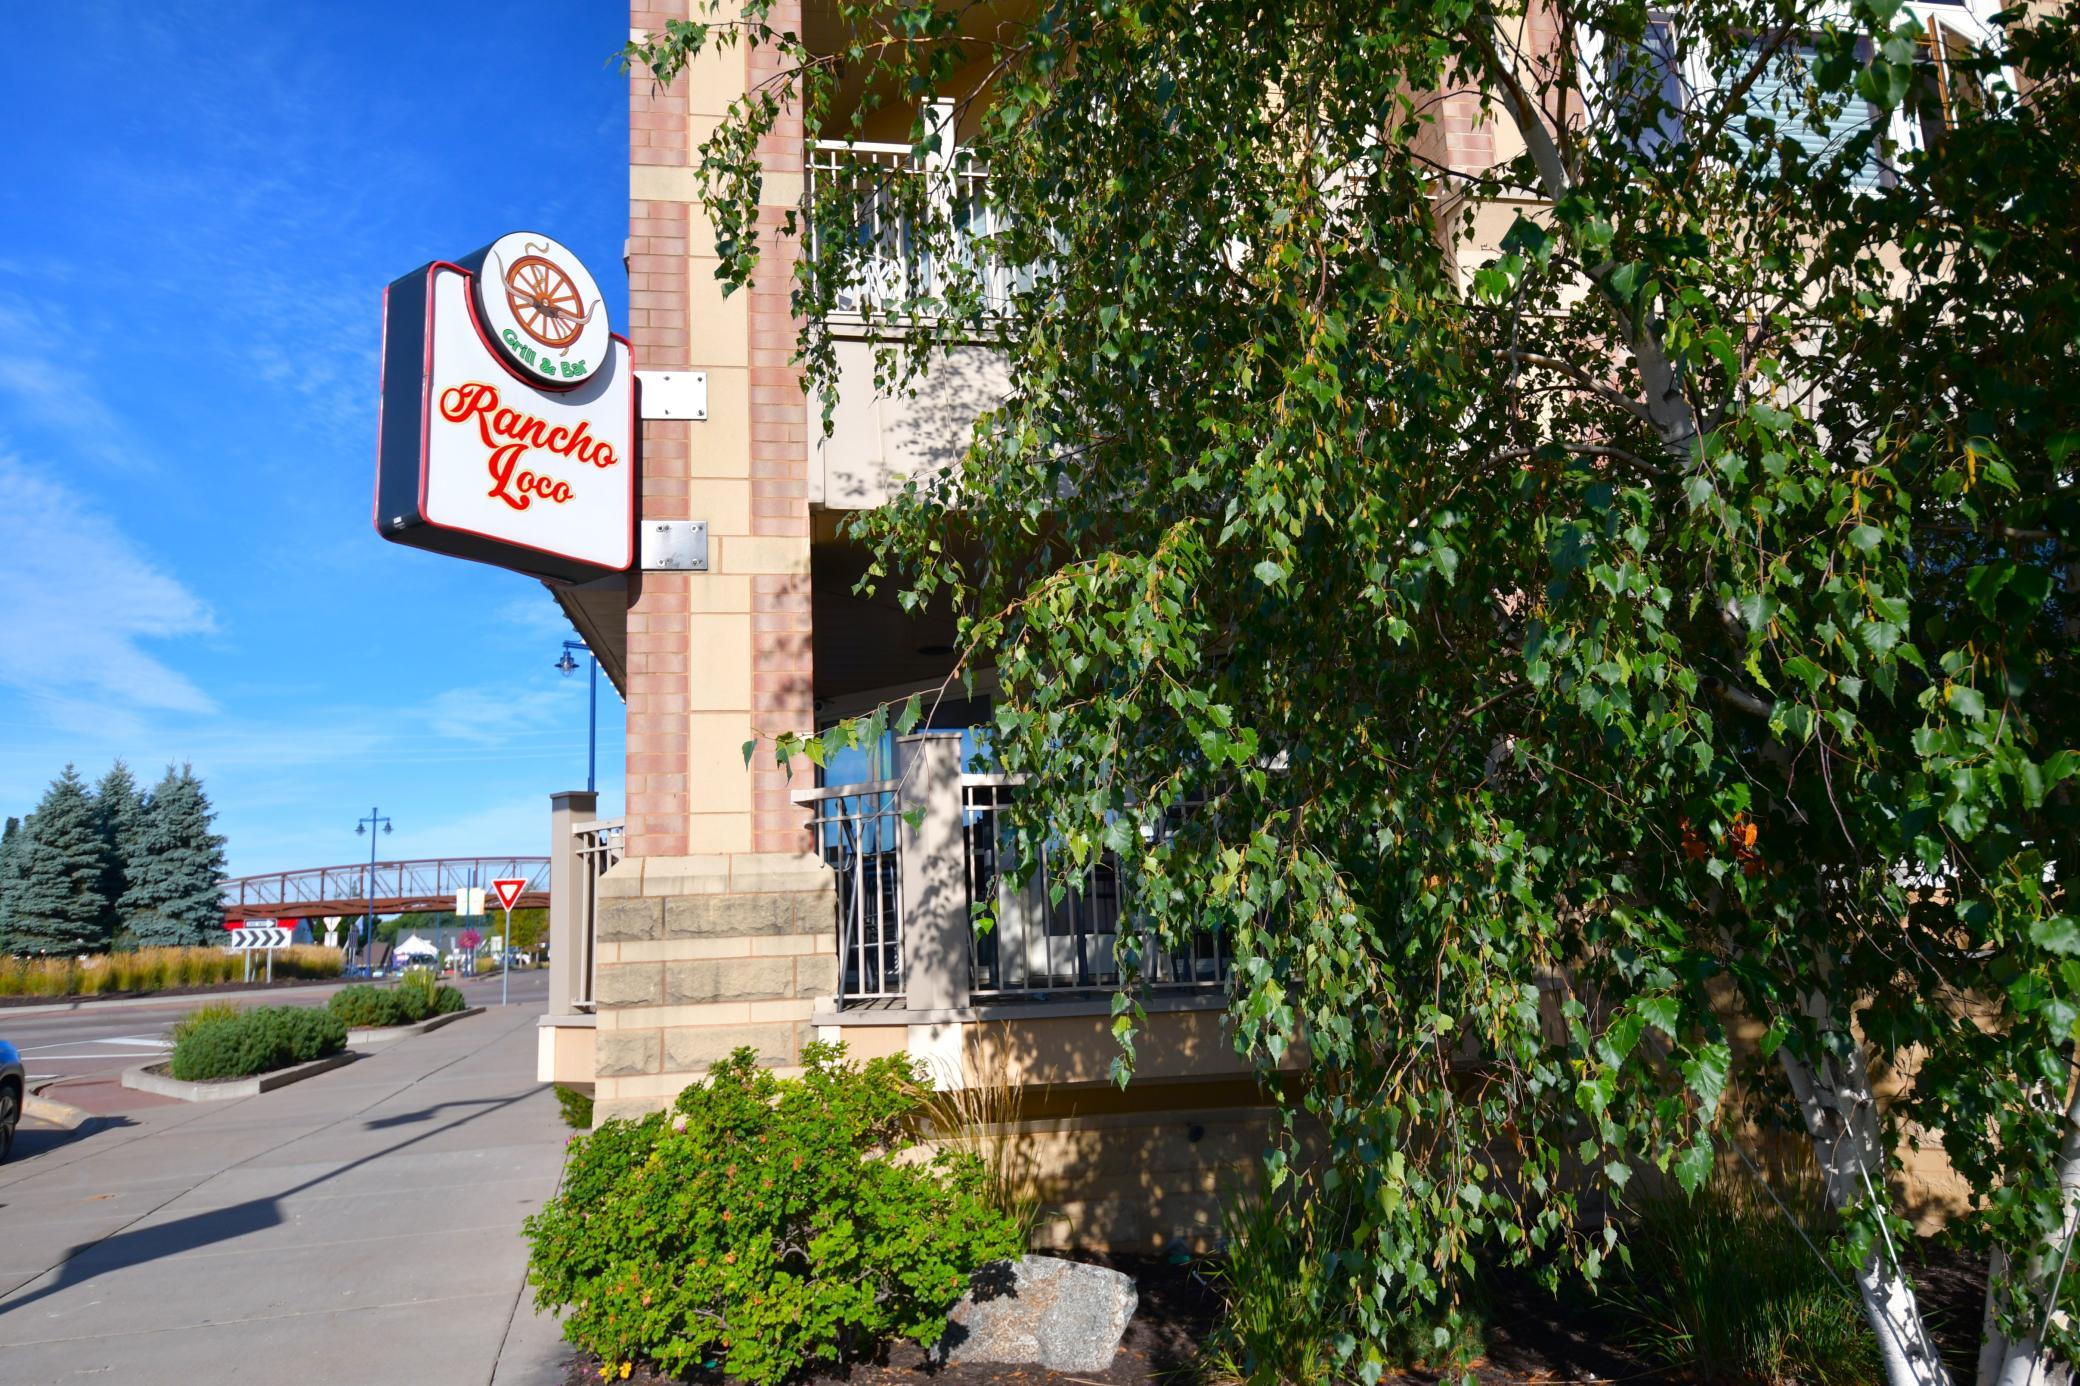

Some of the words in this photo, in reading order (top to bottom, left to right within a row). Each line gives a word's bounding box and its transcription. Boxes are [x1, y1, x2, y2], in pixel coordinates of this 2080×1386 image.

[502, 328, 537, 366] Grill
[540, 357, 556, 376] &
[560, 360, 587, 378] Bar
[439, 383, 618, 468] Rancho
[488, 443, 574, 510] Loco
